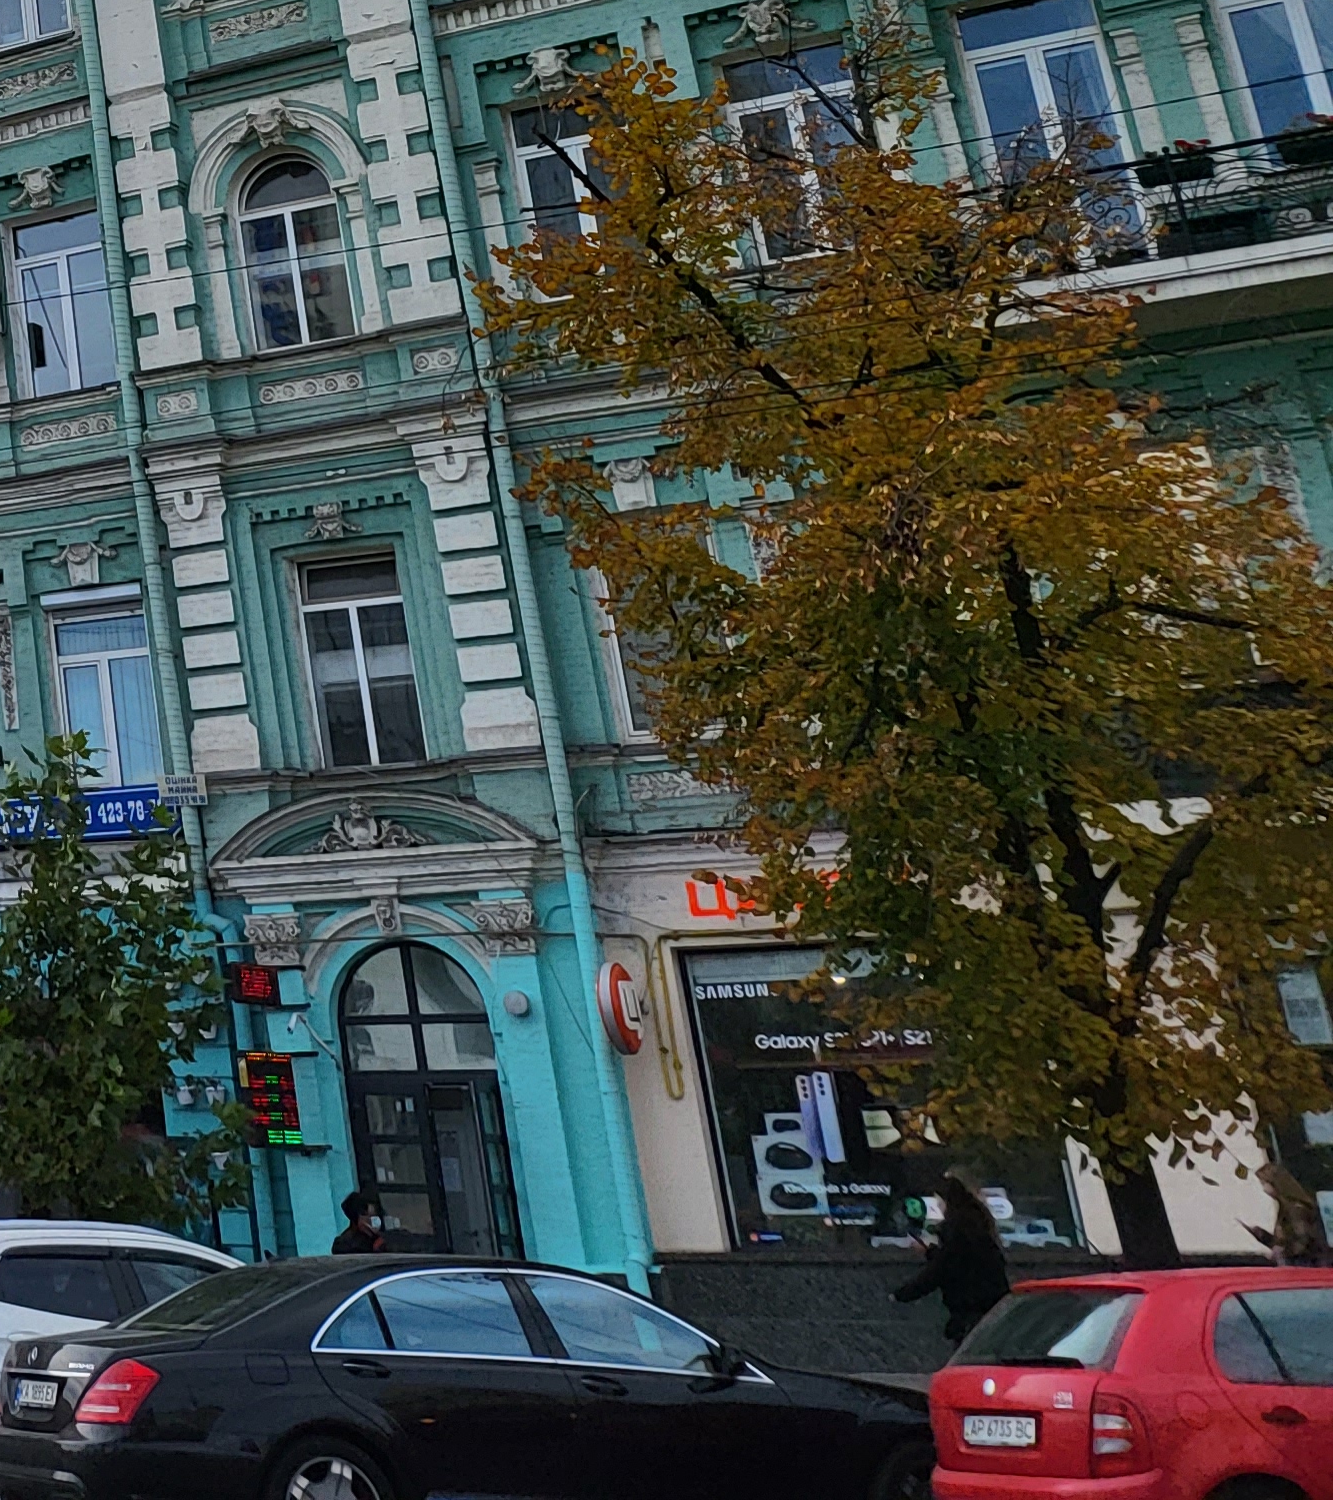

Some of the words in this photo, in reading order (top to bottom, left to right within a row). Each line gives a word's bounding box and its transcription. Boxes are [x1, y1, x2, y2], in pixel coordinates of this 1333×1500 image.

[694, 982, 779, 1001] SAMSUN
[754, 1033, 820, 1050] Galaxy
[970, 1419, 984, 1436] AP
[987, 1419, 1012, 1438] 6735
[1015, 1421, 1033, 1440] BC
